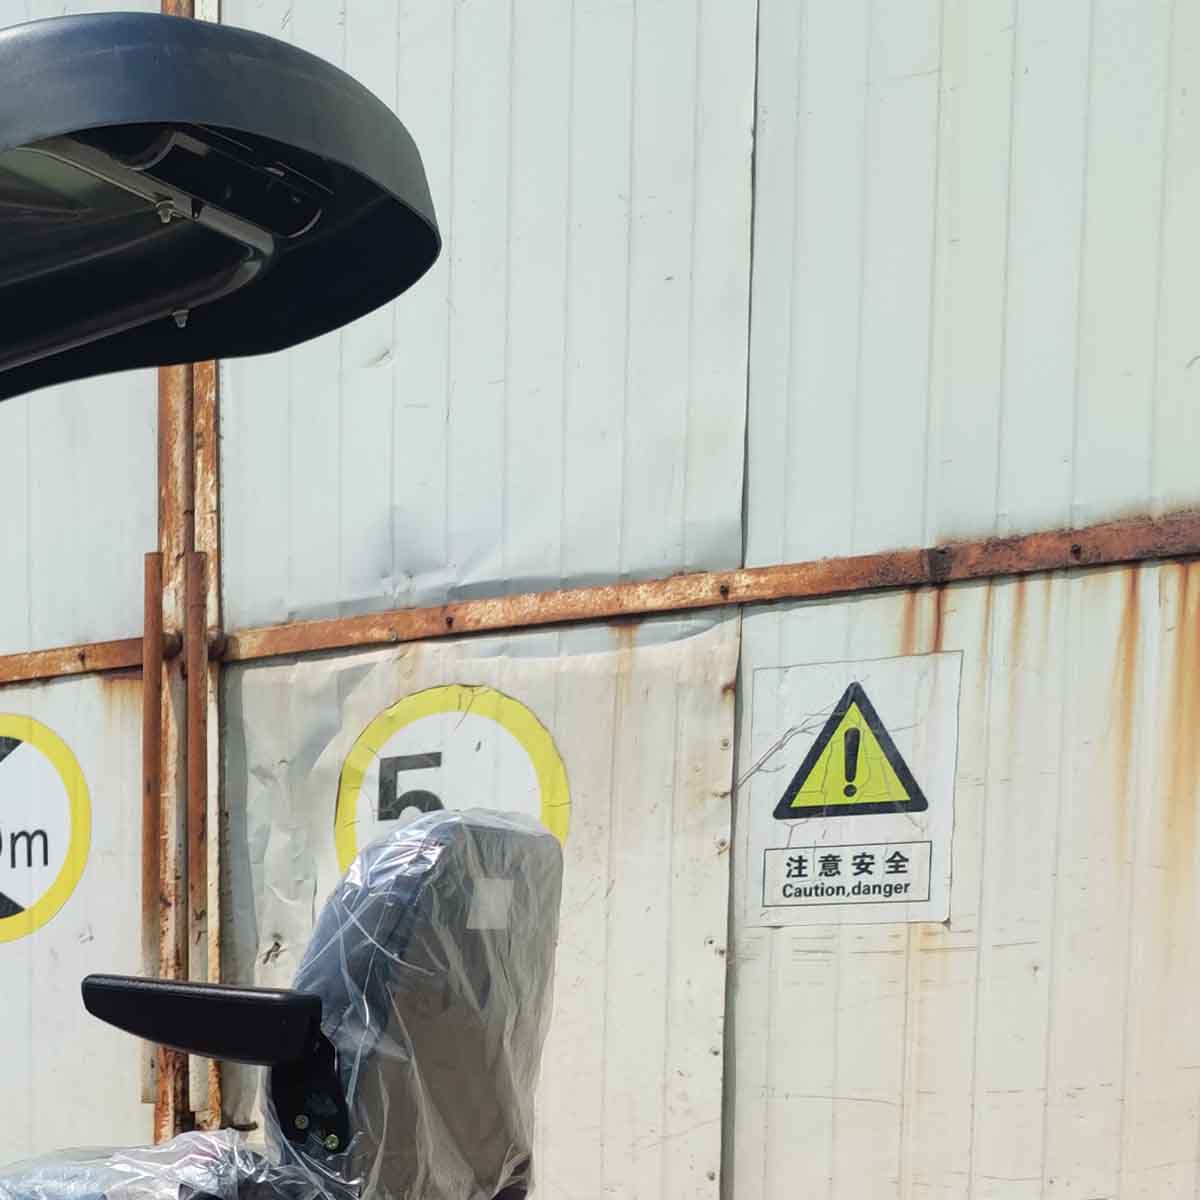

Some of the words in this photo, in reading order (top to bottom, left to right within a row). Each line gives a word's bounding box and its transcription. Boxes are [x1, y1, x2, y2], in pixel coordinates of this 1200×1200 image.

[785, 850, 910, 878] 注意安全
[782, 881, 911, 899] Caution,danger
